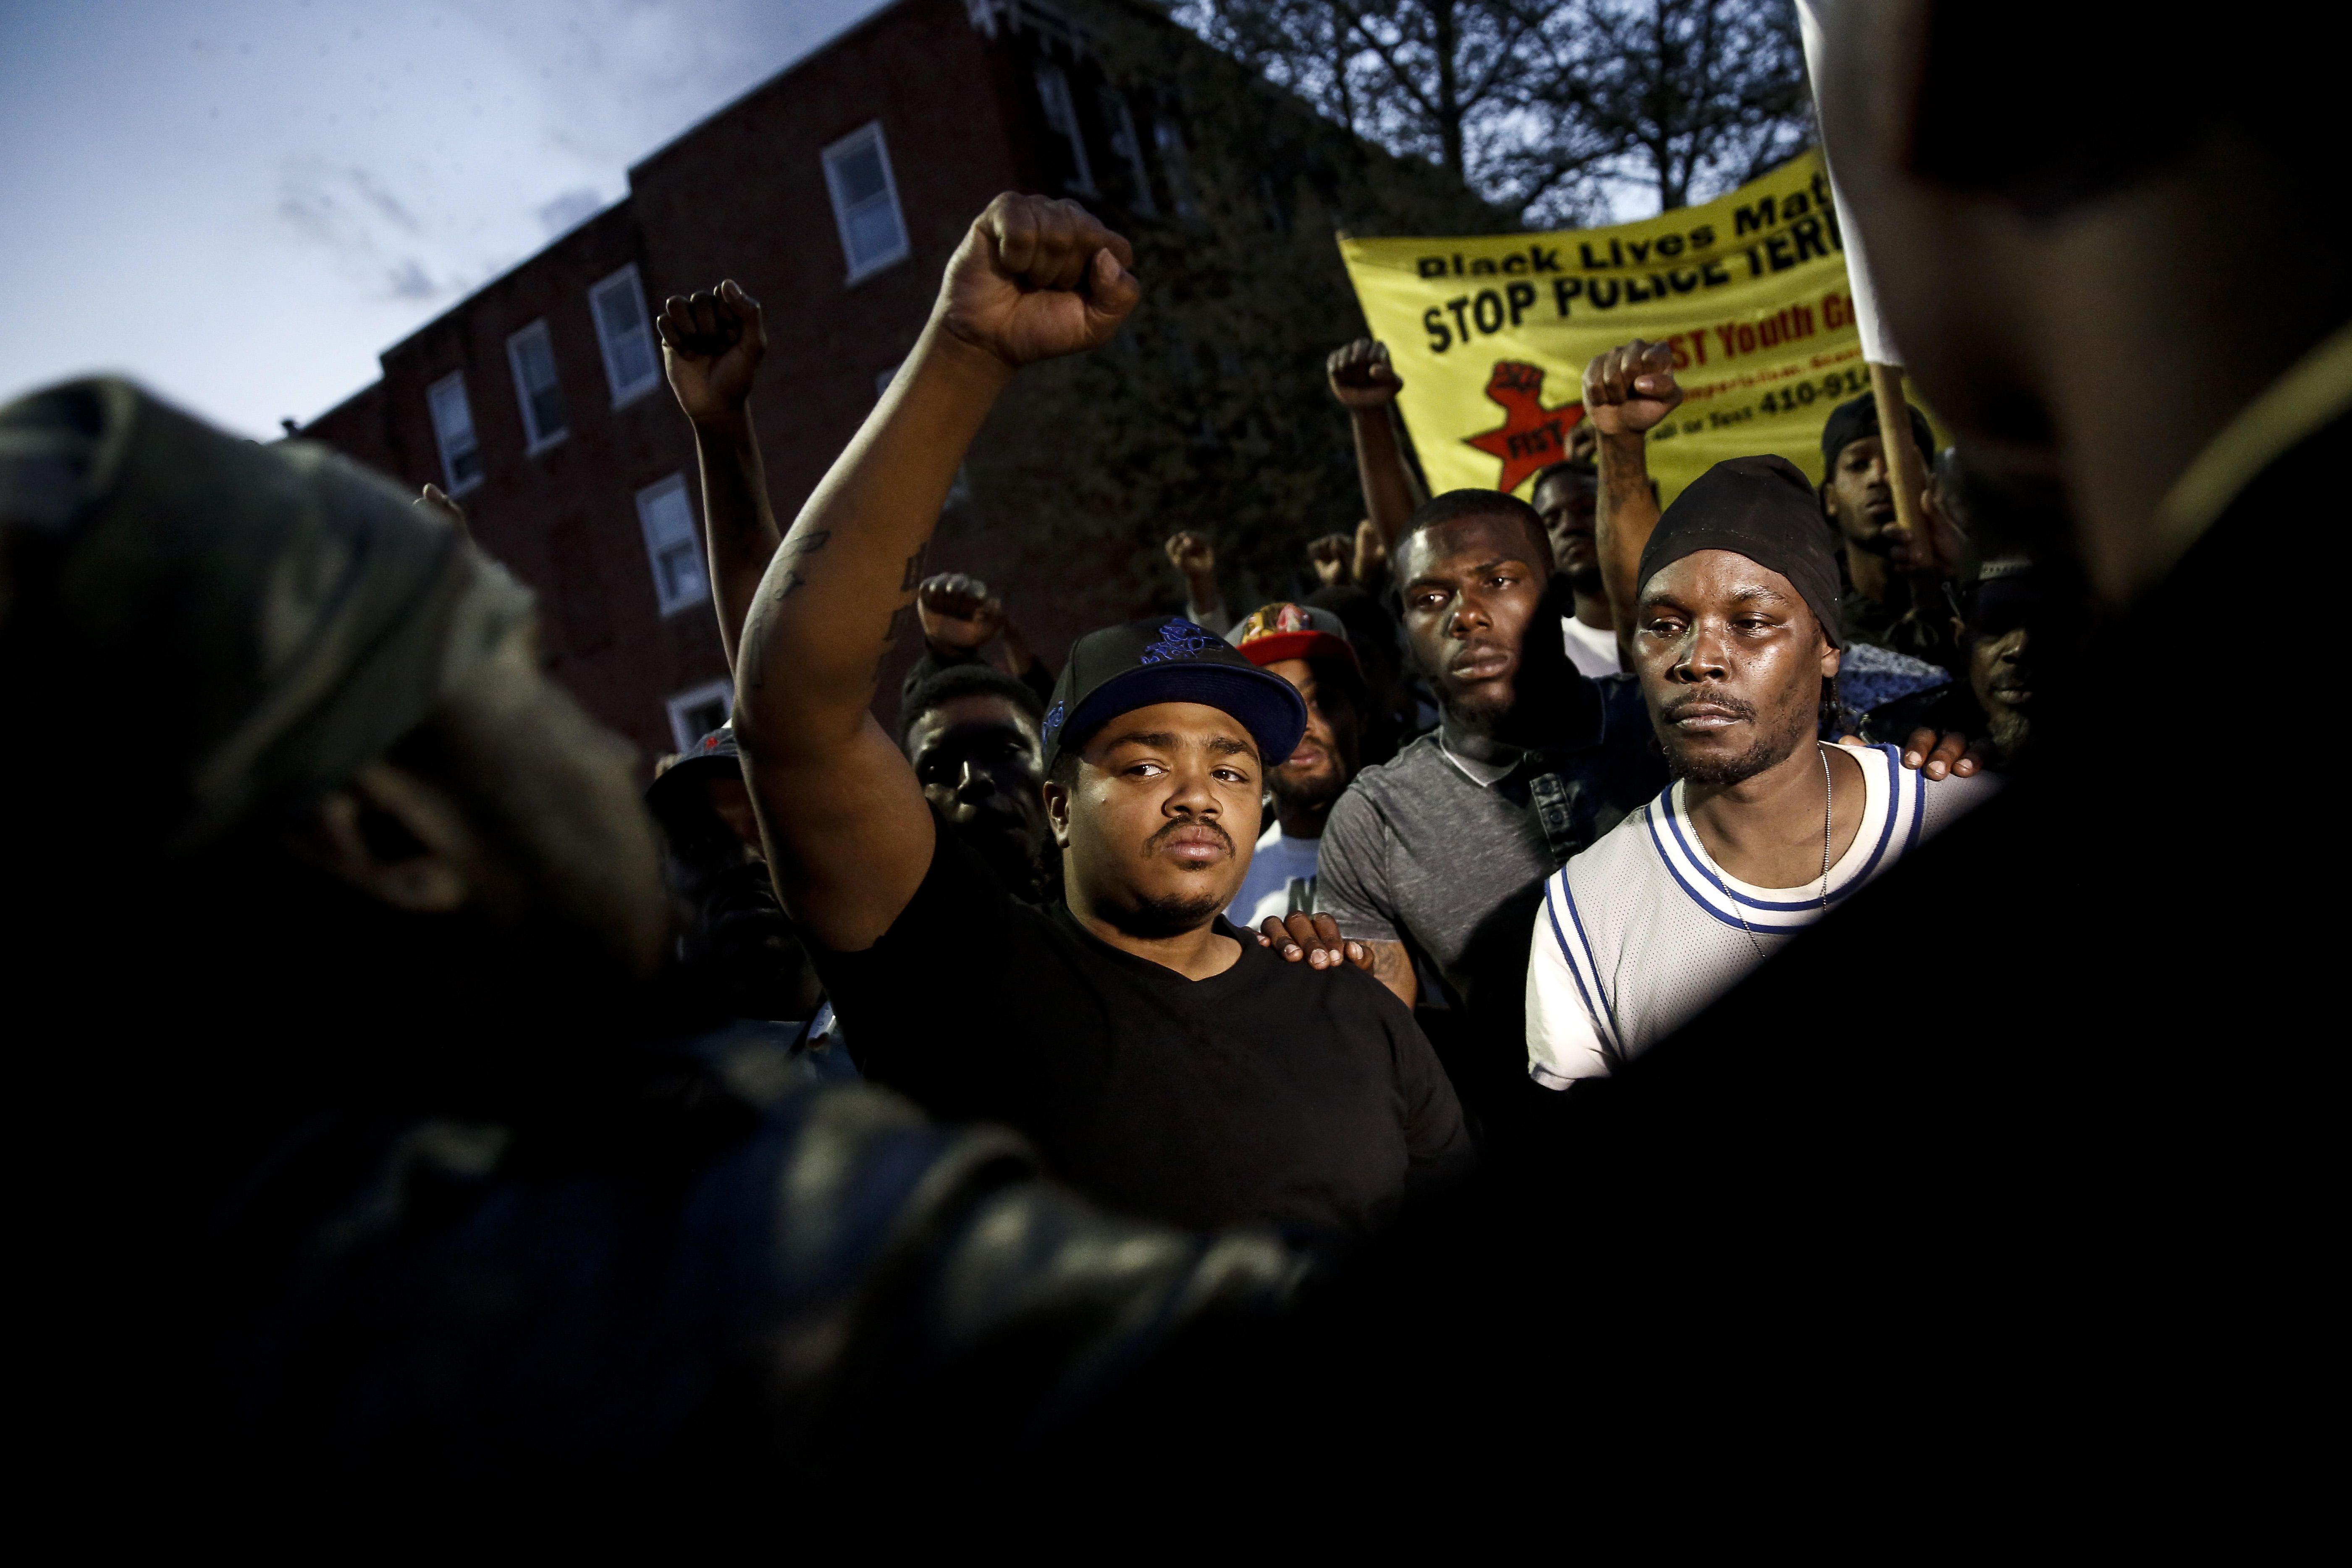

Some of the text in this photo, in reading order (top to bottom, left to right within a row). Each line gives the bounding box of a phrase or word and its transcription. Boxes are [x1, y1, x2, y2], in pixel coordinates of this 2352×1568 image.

[1417, 244, 1560, 278] Black
[1578, 223, 1714, 269] Lives
[1423, 280, 1537, 354] STOP
[1554, 262, 1730, 318] POLICE
[1715, 304, 1814, 358] Youth
[1508, 419, 1563, 459] FIST
